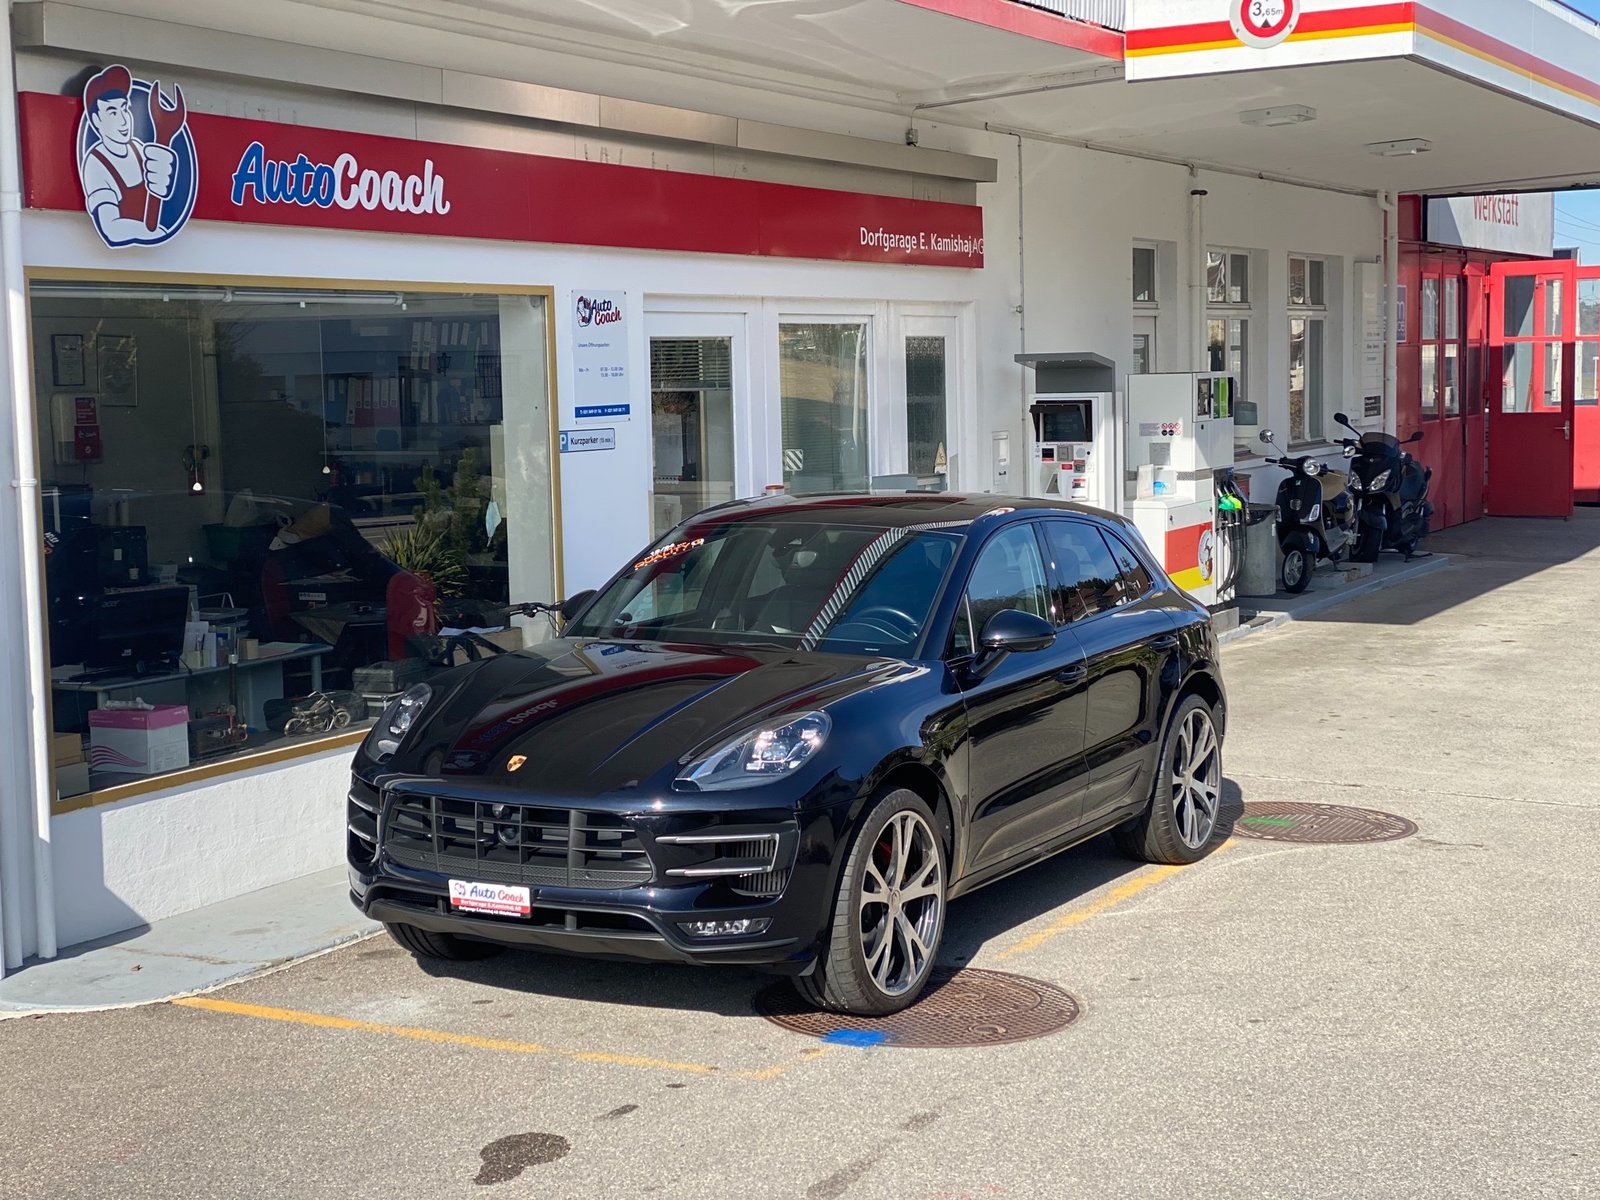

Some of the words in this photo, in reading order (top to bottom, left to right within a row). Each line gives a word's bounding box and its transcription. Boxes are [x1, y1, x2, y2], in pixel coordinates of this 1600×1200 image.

[1473, 194, 1519, 226] Werkstatt
[860, 226, 917, 253] Dorfgarage
[919, 232, 928, 250] E.
[930, 232, 972, 257] Kamishaj
[591, 299, 612, 312] Auto
[594, 306, 622, 326] Coach
[570, 436, 598, 446] Kurzparker
[470, 885, 496, 900] Auto
[498, 889, 525, 904] Coach
